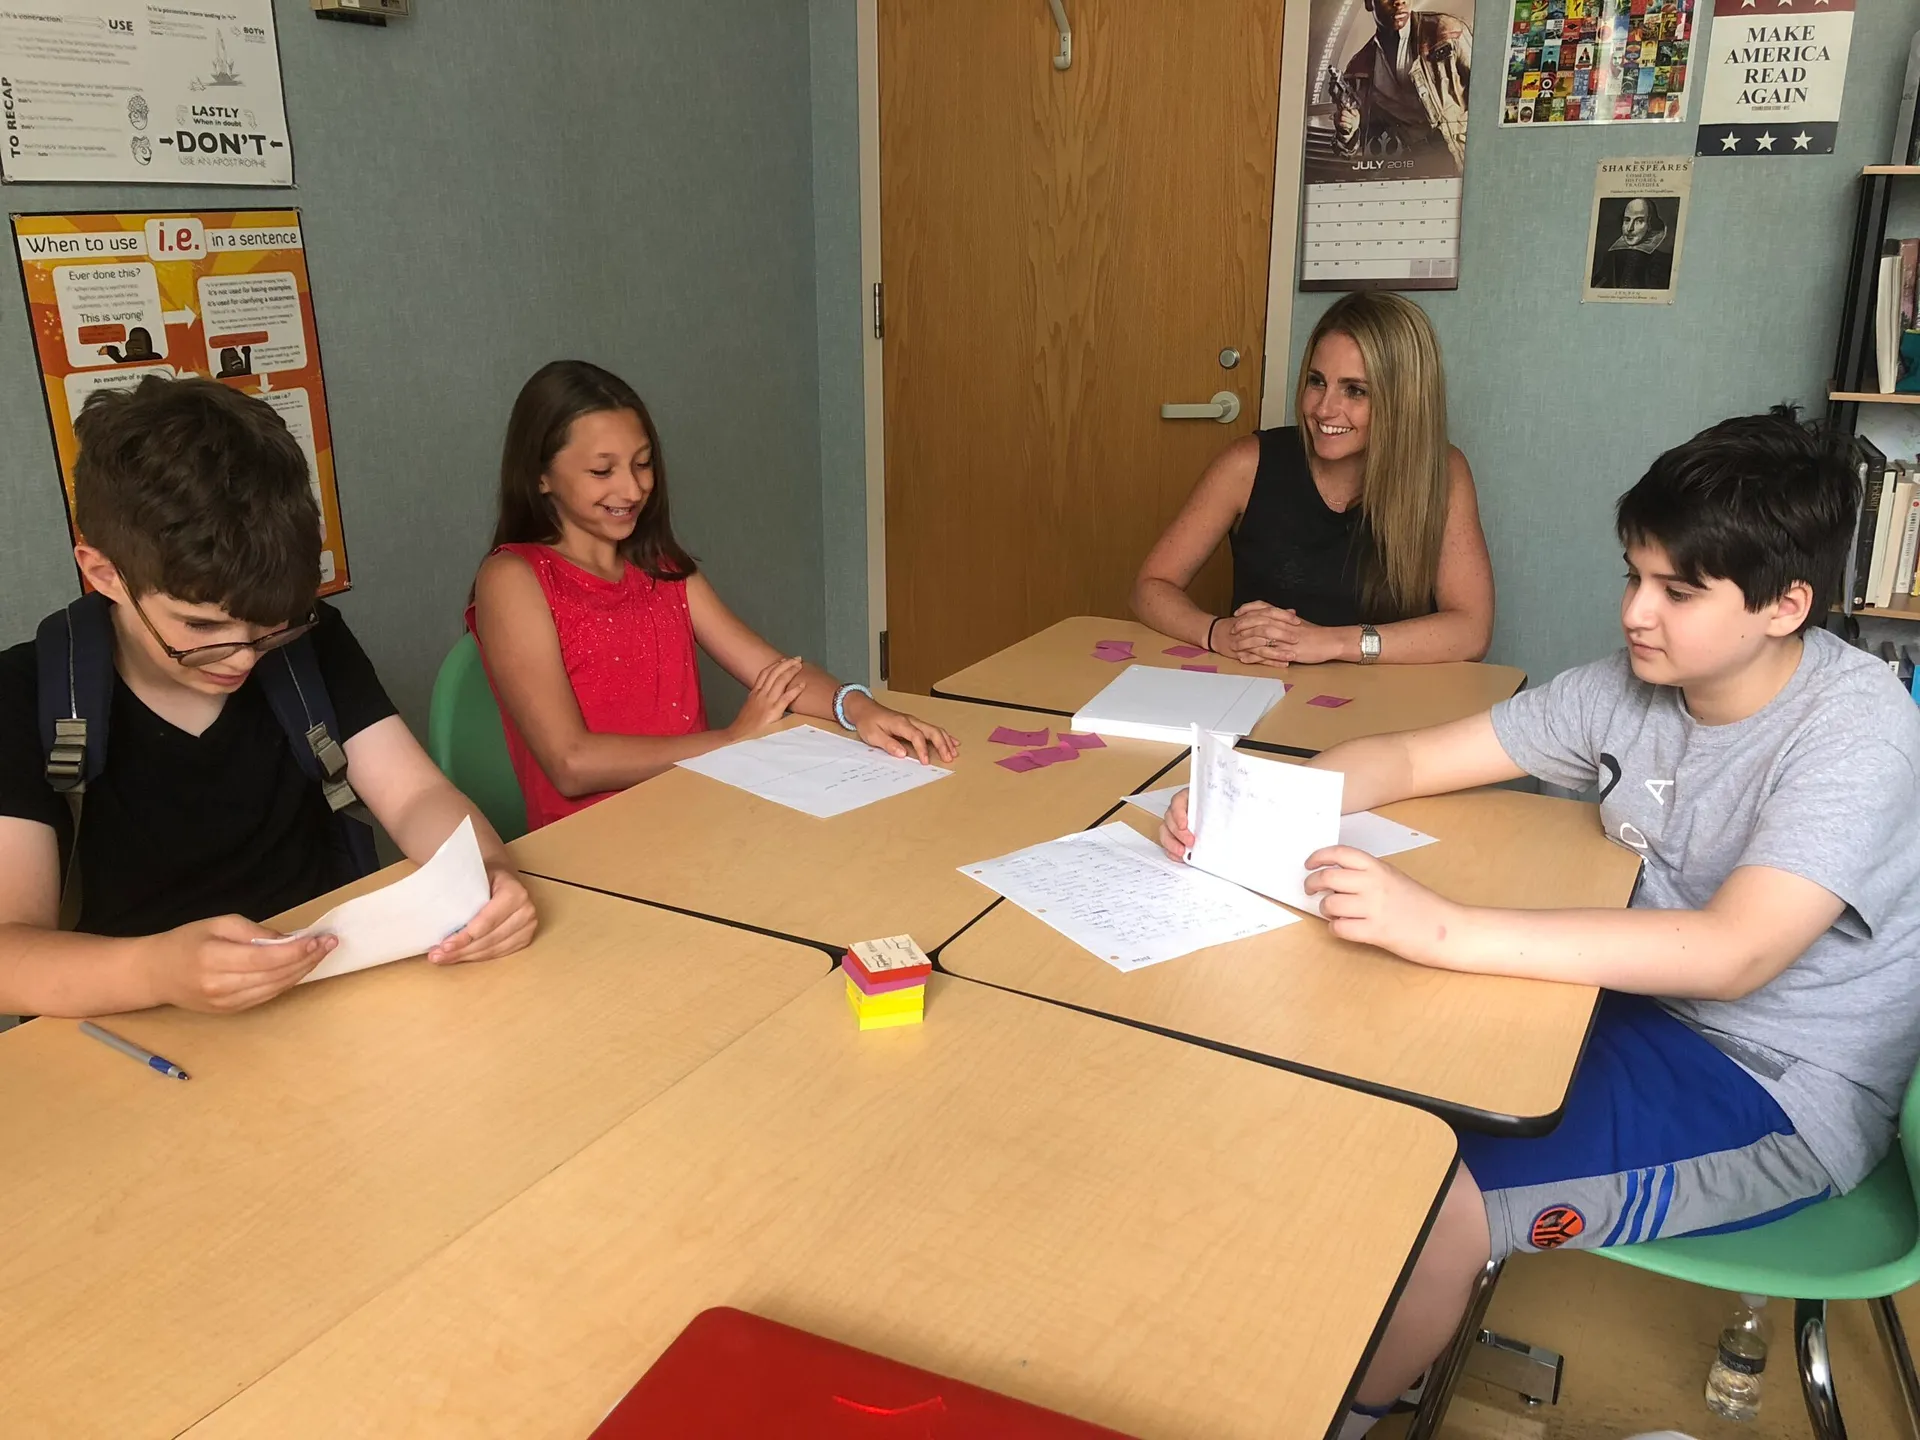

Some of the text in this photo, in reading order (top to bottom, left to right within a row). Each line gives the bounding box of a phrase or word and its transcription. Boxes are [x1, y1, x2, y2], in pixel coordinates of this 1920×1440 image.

[108, 18, 134, 31] USE
[244, 26, 264, 36] BOTH
[1746, 25, 1816, 43] MAKE
[1724, 45, 1831, 64] AMERICA
[1744, 67, 1807, 84] READ
[1736, 87, 1809, 104] AGAIN
[1, 76, 21, 158] TO RECAP
[192, 105, 240, 118] LASTLY
[193, 118, 214, 126] When
[222, 120, 242, 128] doubt
[212, 158, 267, 168] APOSTROPHE
[1352, 160, 1414, 170] JULY 2018
[1601, 164, 1689, 172] SHAKESPEARES
[26, 222, 298, 253] When to use i.e. in a sentence
[69, 268, 141, 280] Ever done this?
[80, 310, 144, 323] This is wrong!
[104, 375, 127, 383] example
